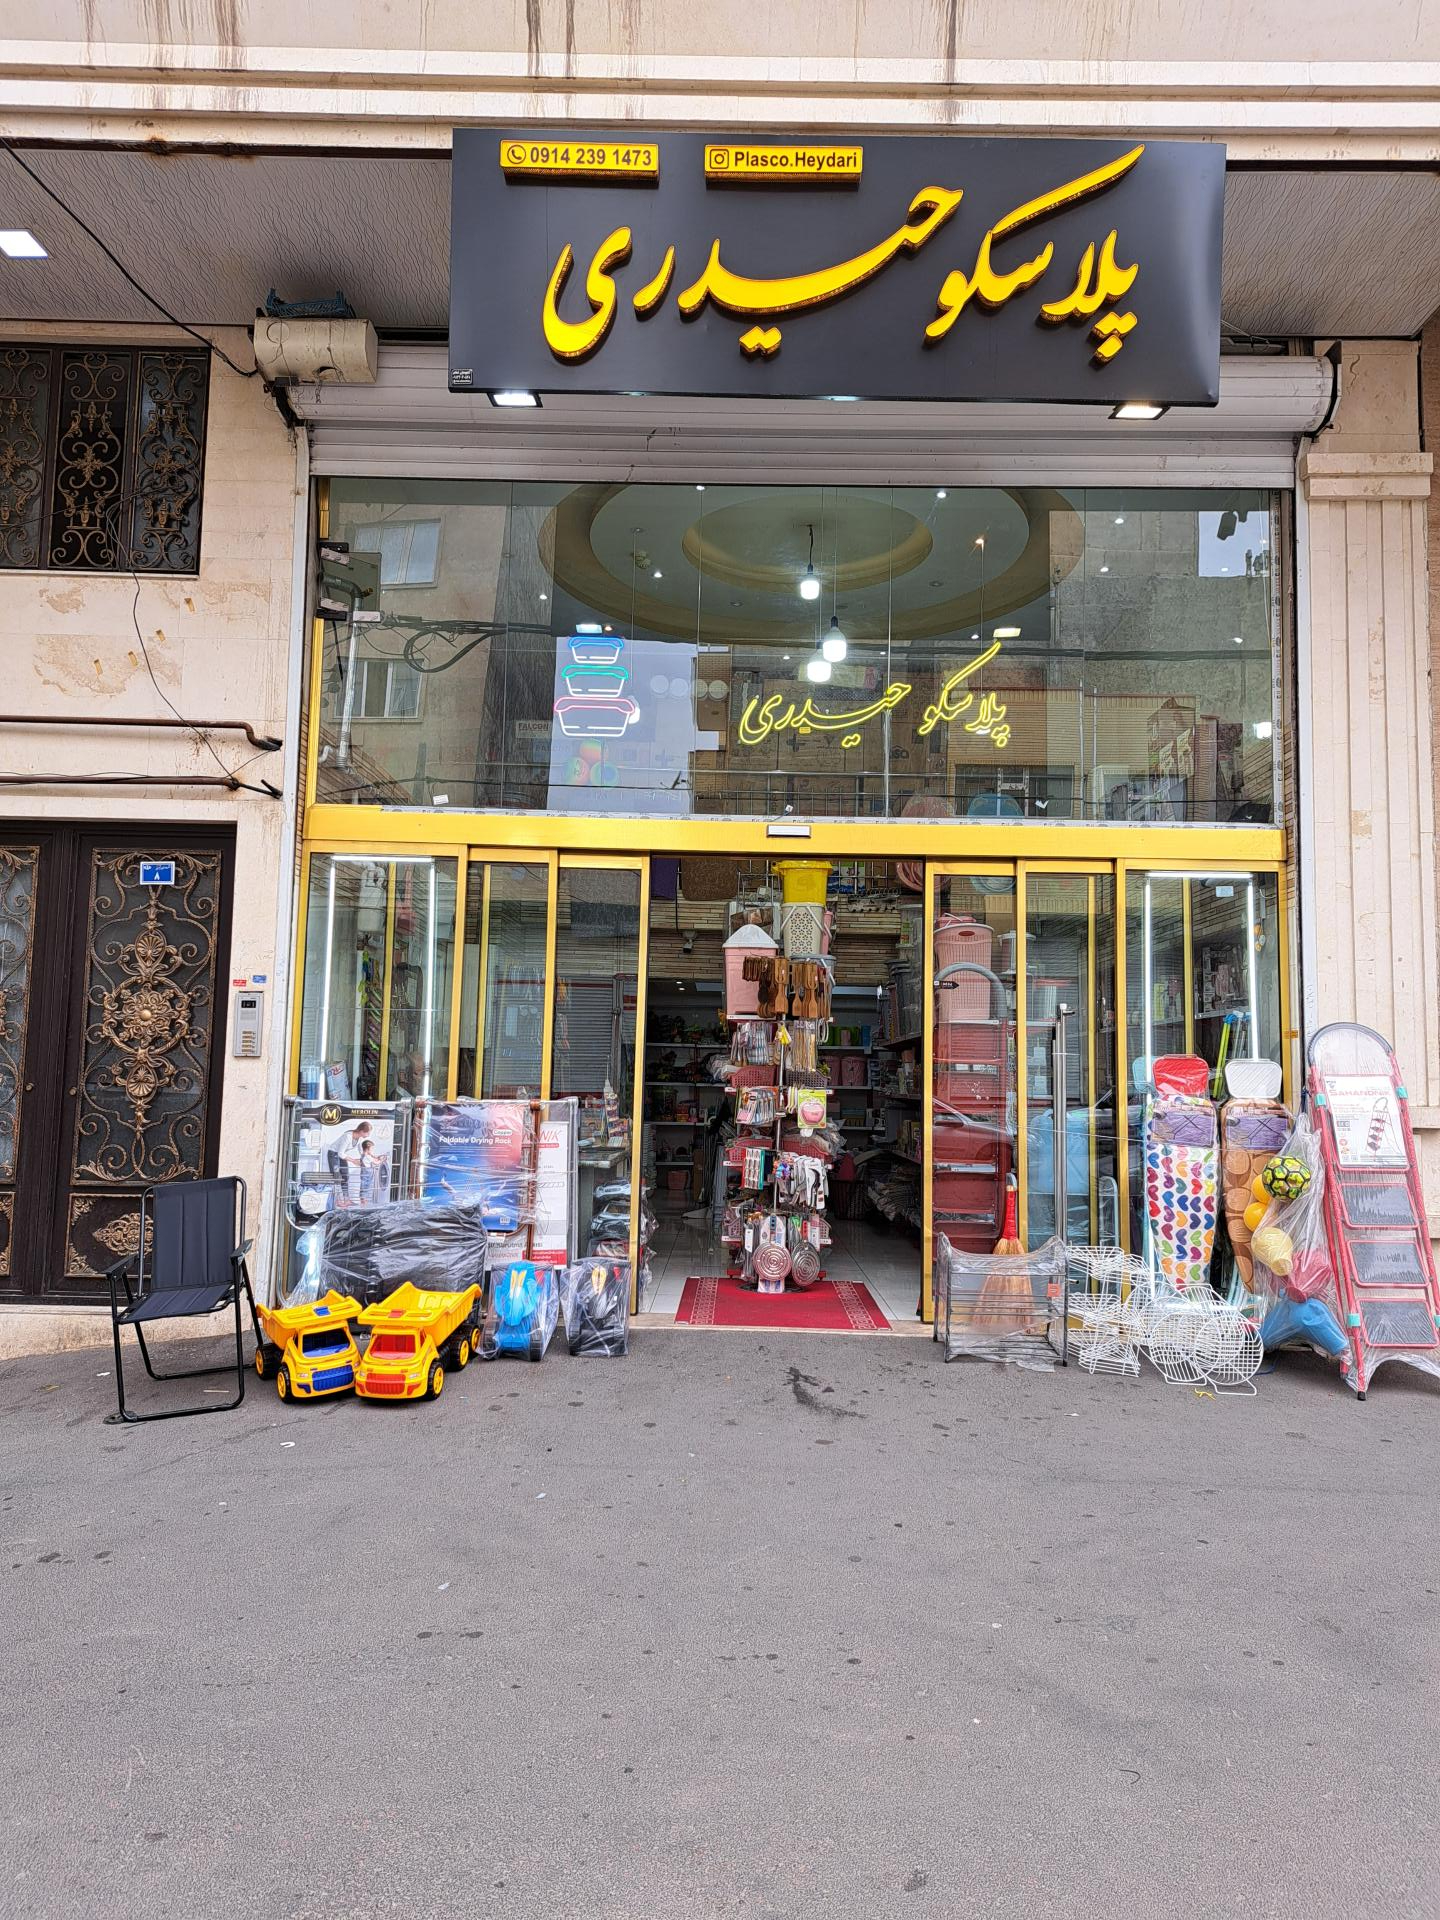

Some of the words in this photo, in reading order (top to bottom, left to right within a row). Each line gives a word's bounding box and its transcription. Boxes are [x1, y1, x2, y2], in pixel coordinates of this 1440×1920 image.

[530, 147, 570, 164] 0914
[575, 148, 606, 165] 239
[612, 149, 651, 166] 1473
[734, 151, 857, 171] Plasco.Heydari
[541, 184, 965, 360] حیدری
[925, 143, 1146, 362] پلاسکو
[738, 682, 912, 748] حیدری
[918, 641, 1010, 748] پلاسکو
[439, 1136, 469, 1144] Foldable
[470, 1136, 493, 1145] Drying
